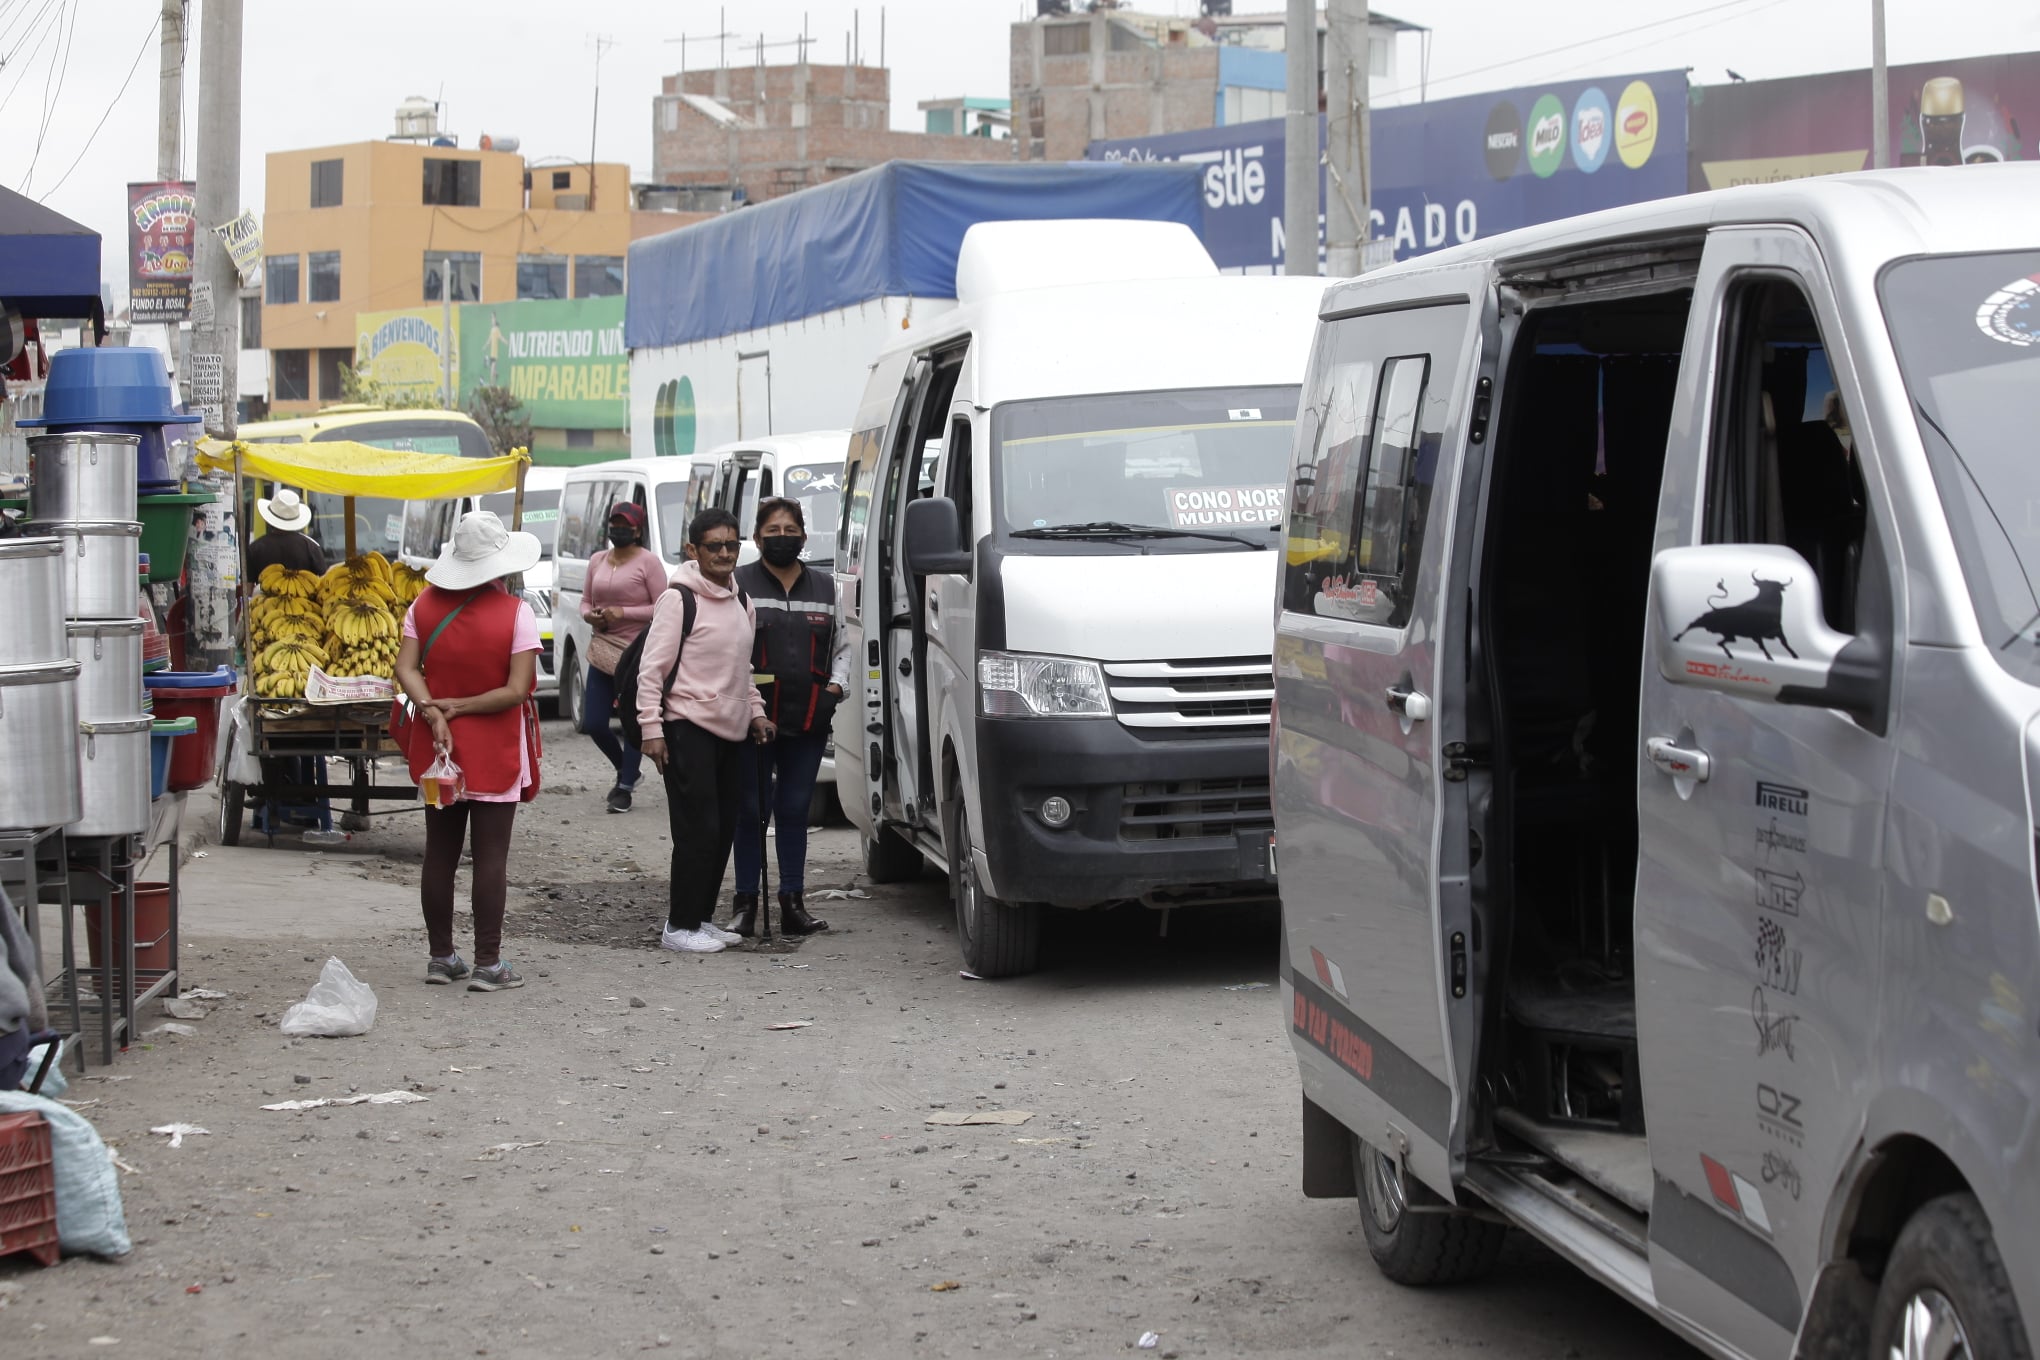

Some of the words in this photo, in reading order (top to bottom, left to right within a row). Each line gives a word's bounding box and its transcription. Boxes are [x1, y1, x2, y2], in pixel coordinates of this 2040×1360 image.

[1535, 127, 1560, 147] MILO
[217, 212, 258, 247] PLANOS
[131, 298, 155, 310] FUNDO
[155, 298, 164, 310] EL
[165, 297, 186, 309] ROSAL
[371, 317, 440, 360] BIENVENIDOS
[508, 330, 593, 358] NUTRIENDO
[1174, 490, 1232, 510] CONO
[1756, 781, 1808, 816] PIRELLI
